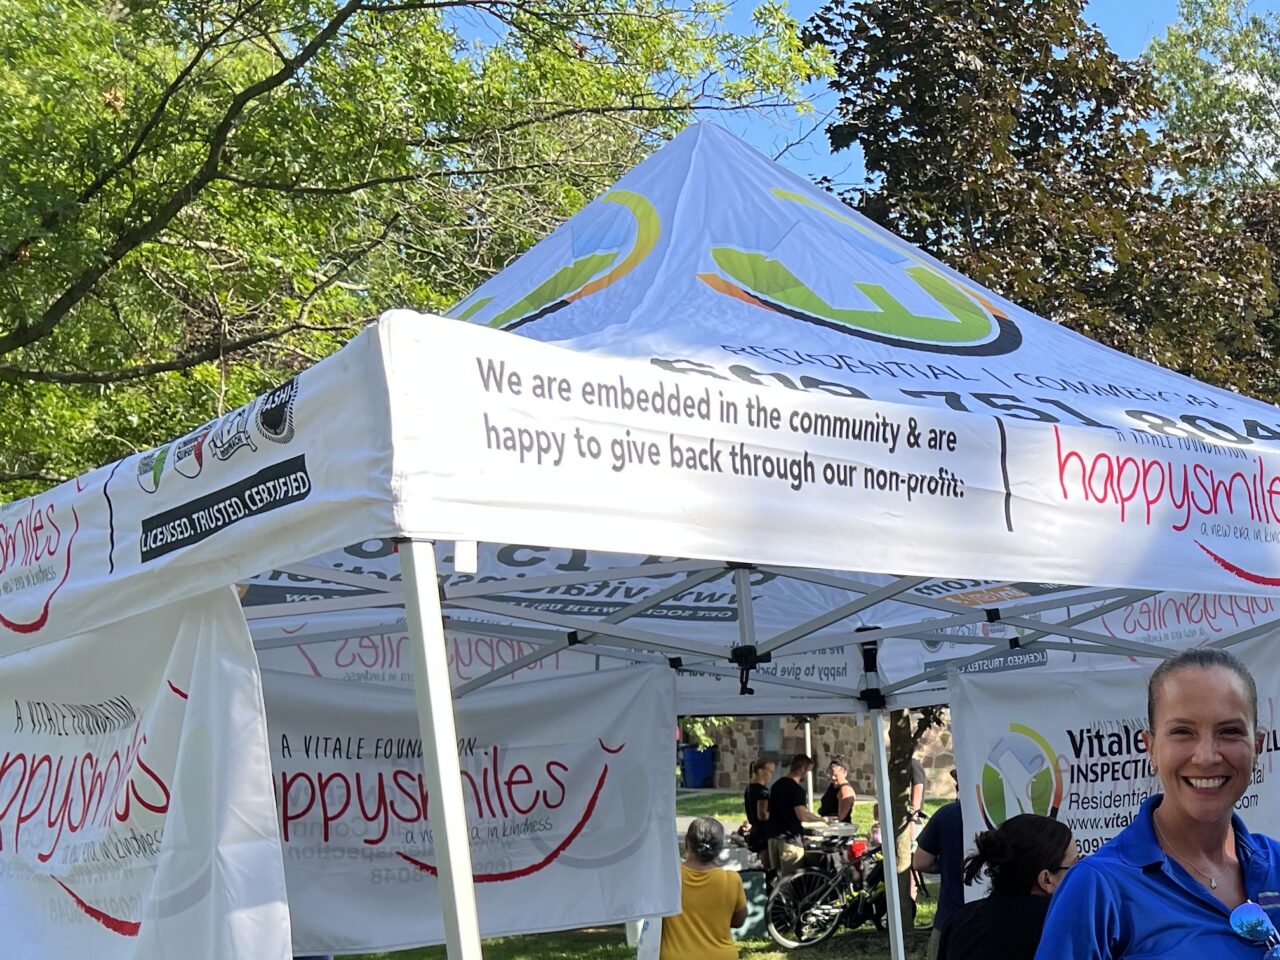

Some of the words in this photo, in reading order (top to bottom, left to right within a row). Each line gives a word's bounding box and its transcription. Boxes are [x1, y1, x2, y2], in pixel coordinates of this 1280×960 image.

[720, 344, 980, 382] RESIDENTIAL
[476, 357, 522, 395] We
[532, 374, 572, 402] are
[582, 375, 710, 421] embedded
[719, 391, 738, 425] in
[747, 396, 781, 430] the
[789, 410, 900, 453] community
[907, 417, 921, 448] &
[928, 427, 957, 452] are
[484, 412, 565, 466] happy
[574, 427, 601, 459] to
[610, 429, 660, 472] give
[669, 433, 723, 473] back
[729, 442, 816, 490] through
[823, 462, 857, 487] our
[864, 465, 964, 501] non-profit:
[141, 518, 194, 552] LICENSED.
[192, 497, 249, 533] TRUSTED.
[245, 472, 309, 511] CERTIFIED
[1201, 525, 1209, 536] a
[1211, 523, 1231, 538] new
[1234, 526, 1250, 542] era
[281, 734, 291, 759] A
[303, 735, 365, 759] VITALE
[375, 738, 477, 760] FOUNON
[1066, 725, 1148, 759] Vitale
[1070, 757, 1157, 784] INSPECTIO
[502, 819, 554, 838] kindness
